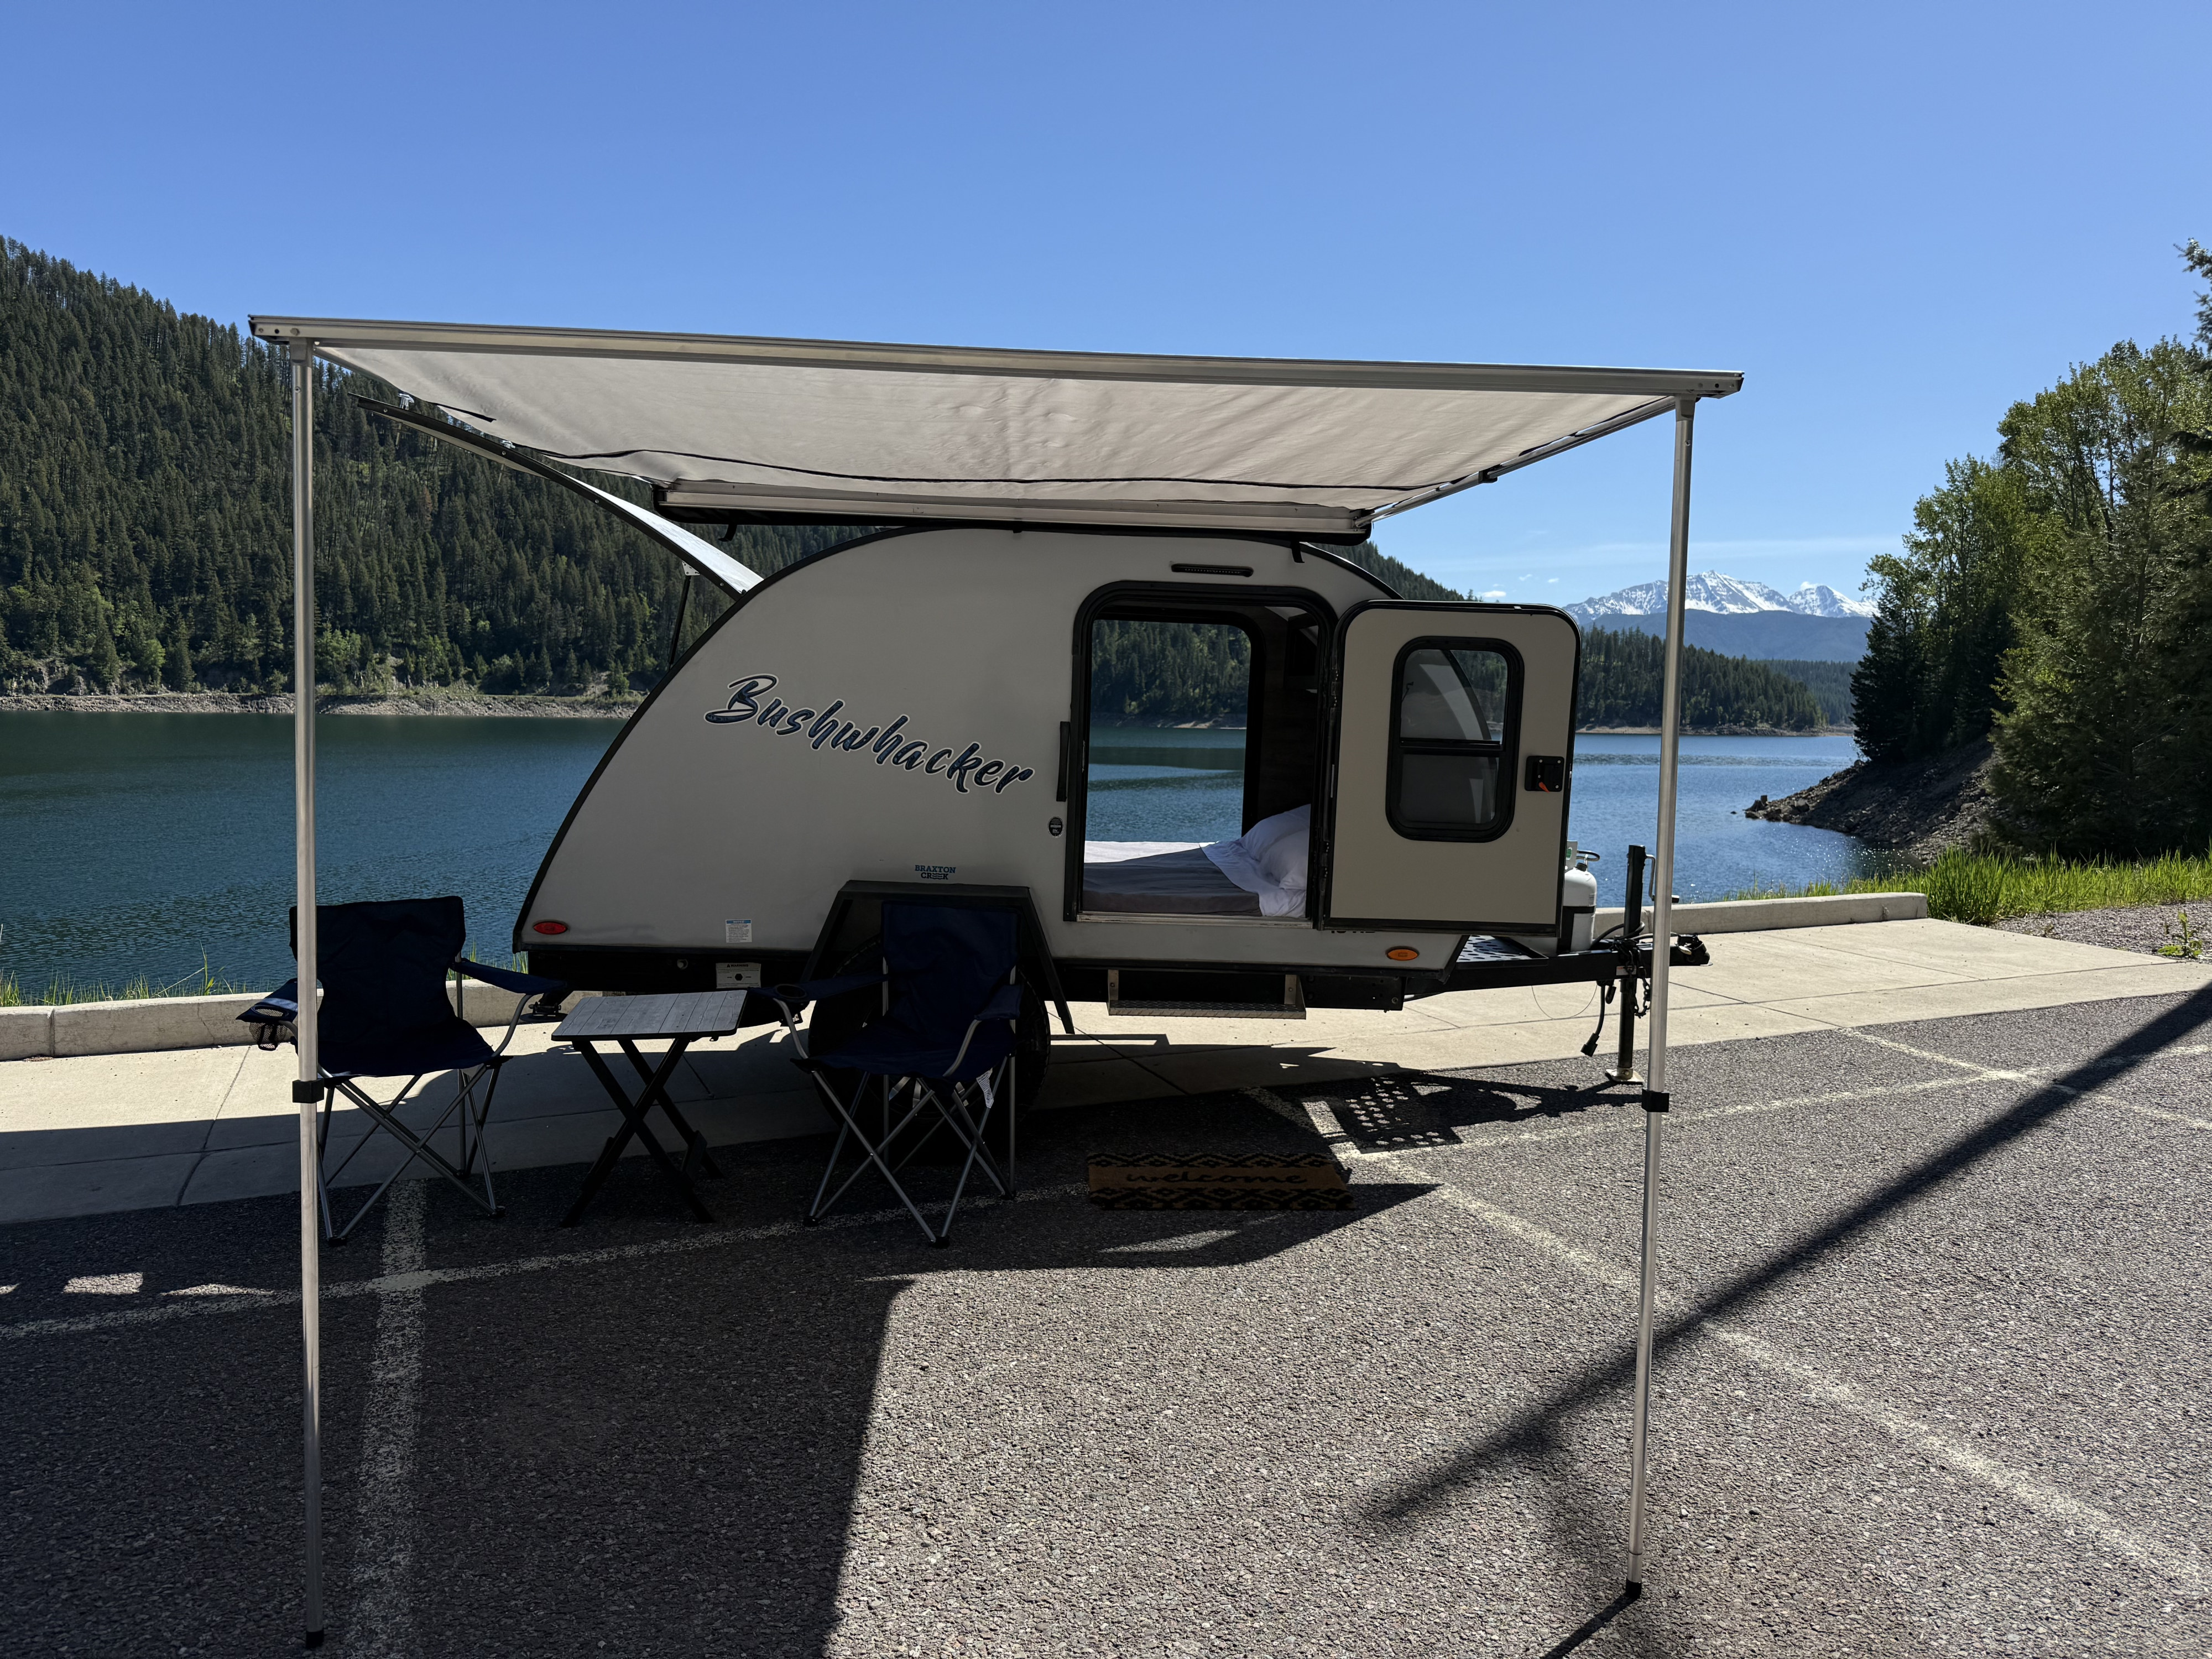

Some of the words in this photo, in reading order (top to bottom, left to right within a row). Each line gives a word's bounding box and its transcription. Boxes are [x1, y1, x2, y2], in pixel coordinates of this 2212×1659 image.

[705, 674, 1034, 794] Bushwhacker
[915, 864, 956, 873] BRAXTON
[1126, 1171, 1308, 1184] welcome
